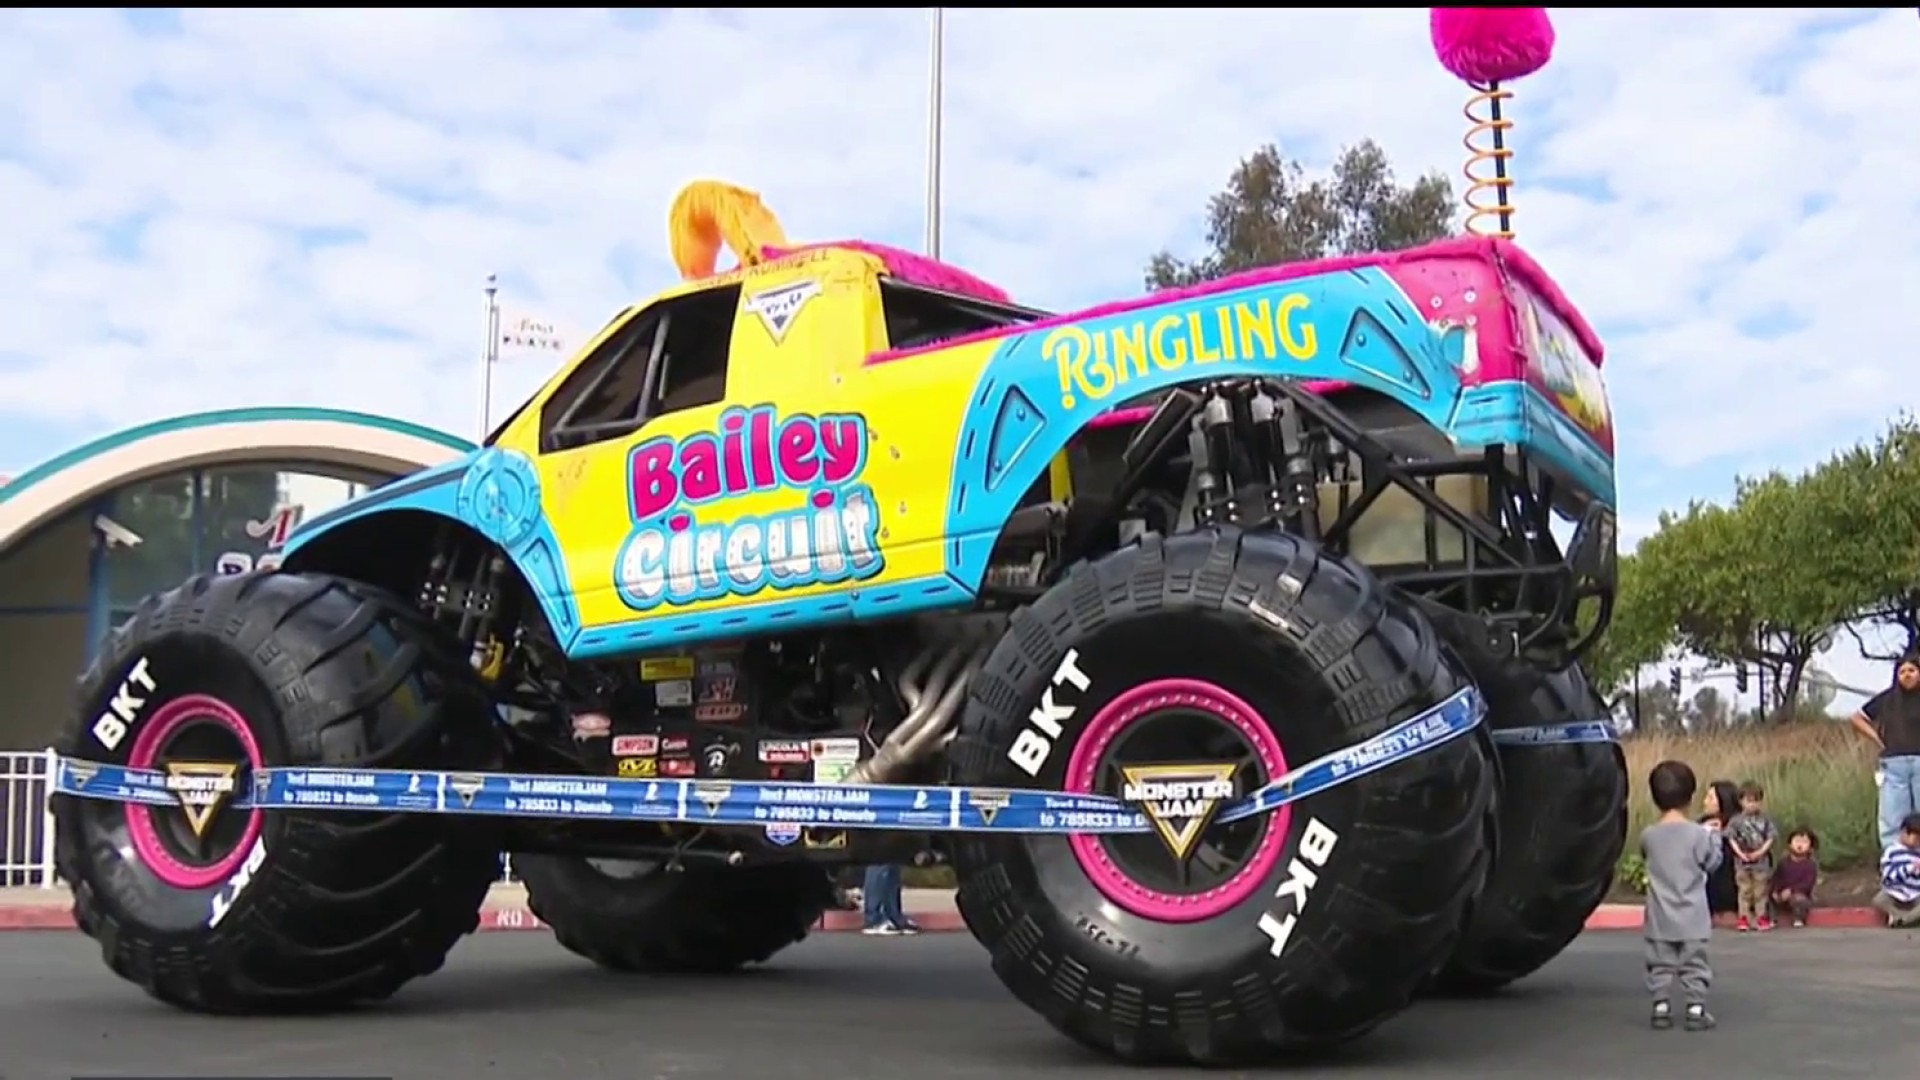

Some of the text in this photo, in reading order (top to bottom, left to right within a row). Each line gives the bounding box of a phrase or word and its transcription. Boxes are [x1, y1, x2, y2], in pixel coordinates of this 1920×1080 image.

[1042, 293, 1318, 409] RINGLING
[630, 405, 862, 521] Bailey
[618, 487, 880, 606] Circuit
[93, 656, 157, 750] BKT
[1007, 648, 1091, 777] BKT
[167, 776, 233, 791] MONSTER
[1124, 781, 1234, 801] MONSTER
[784, 788, 870, 804] MONSTERJAM
[754, 806, 767, 819] to
[817, 807, 830, 821] to
[1157, 800, 1204, 818] JAM
[1040, 812, 1055, 827] to
[1058, 812, 1113, 827] 785833
[1117, 812, 1132, 827] to
[1257, 817, 1339, 957] BKT
[497, 909, 522, 927] NO
